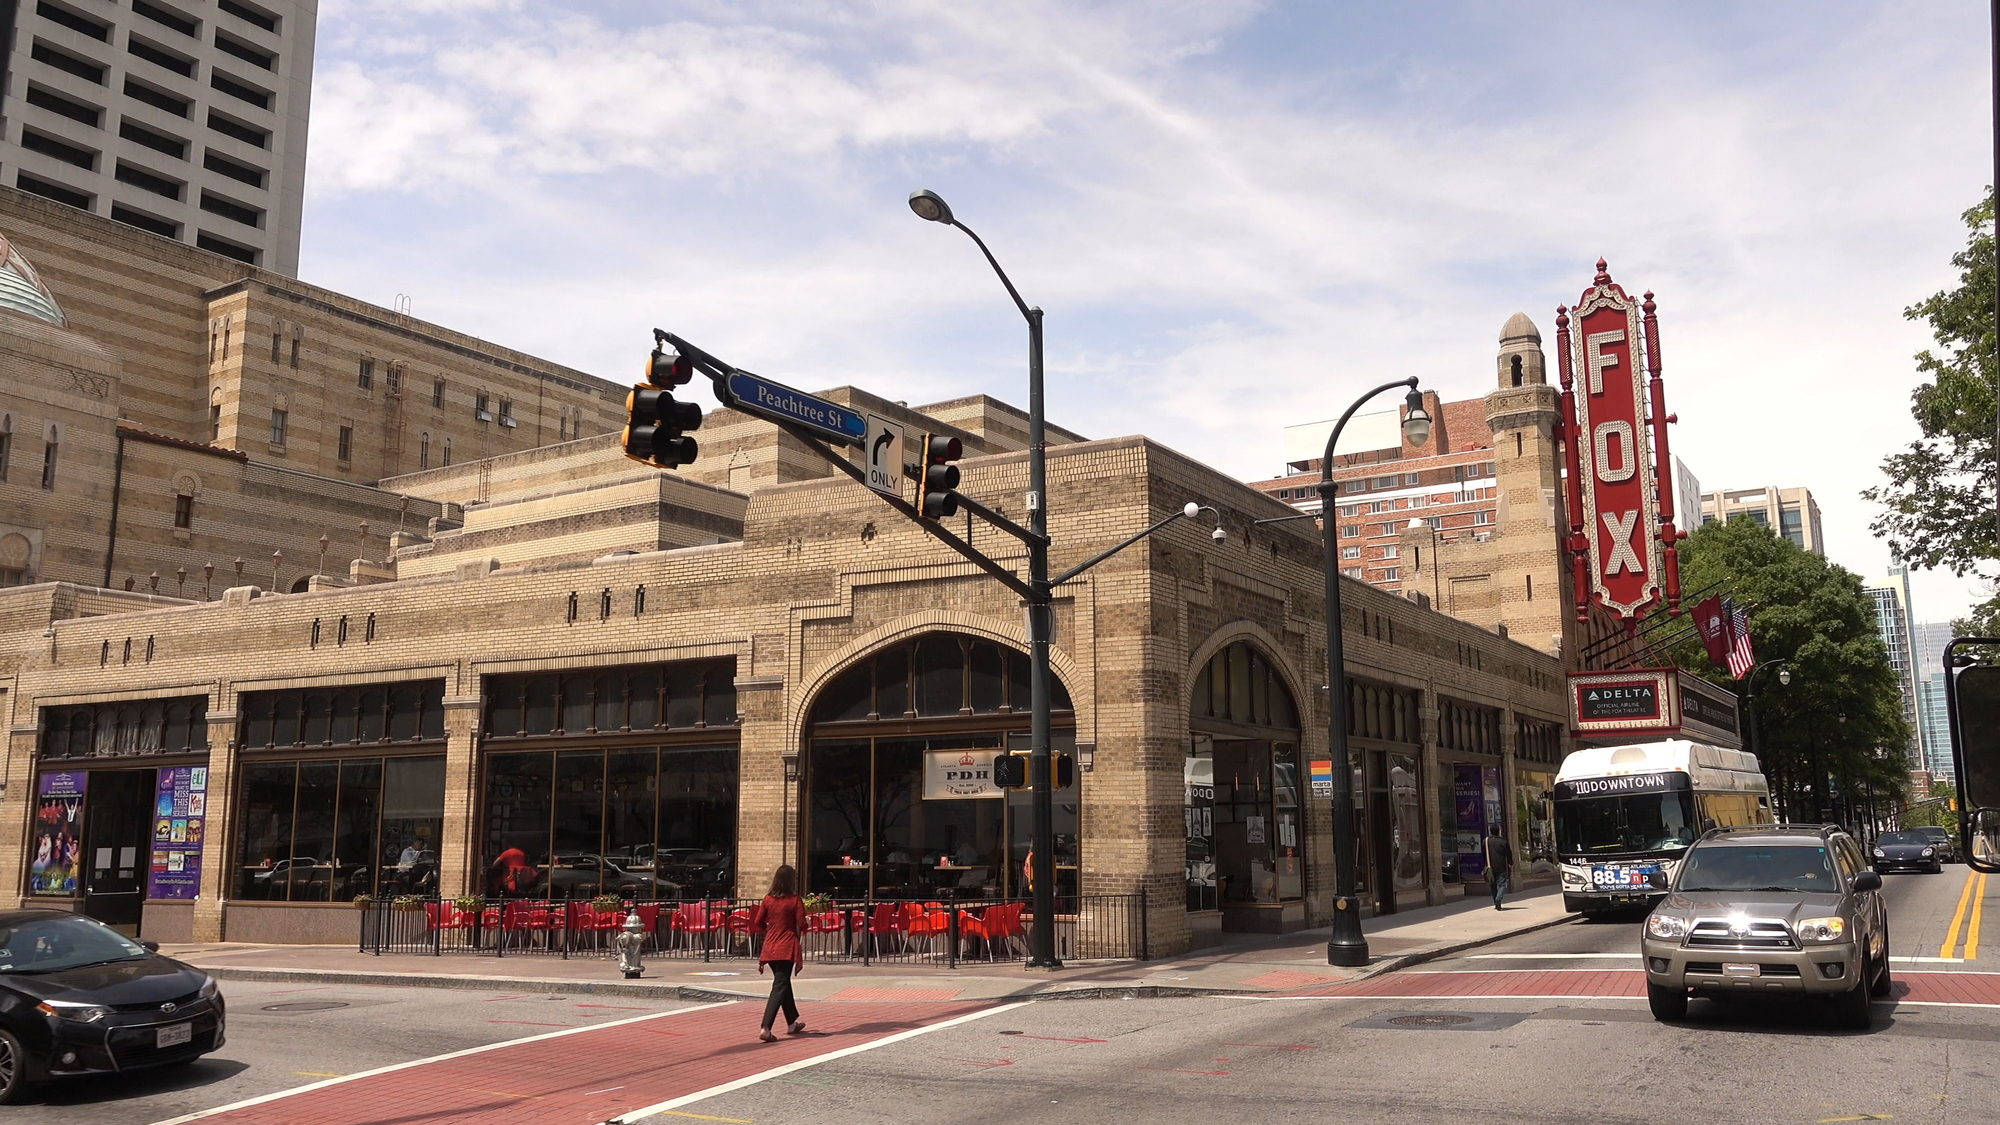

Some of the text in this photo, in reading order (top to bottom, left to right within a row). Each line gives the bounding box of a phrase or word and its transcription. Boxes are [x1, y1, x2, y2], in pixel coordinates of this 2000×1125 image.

[757, 385, 843, 429] Peachtree St
[1586, 329, 1644, 575] FOX
[871, 469, 898, 490] ONLY
[1603, 688, 1652, 700] DELTA
[1596, 702, 1619, 710] OFFICIAL
[1575, 775, 1665, 795] 110 DOWNTOWN
[174, 790, 190, 798] MISS
[173, 798, 189, 807] THIS
[1576, 843, 1582, 852] 1
[1569, 857, 1587, 865] 1446
[1593, 870, 1630, 885] 88.5
[1632, 874, 1650, 884] np
